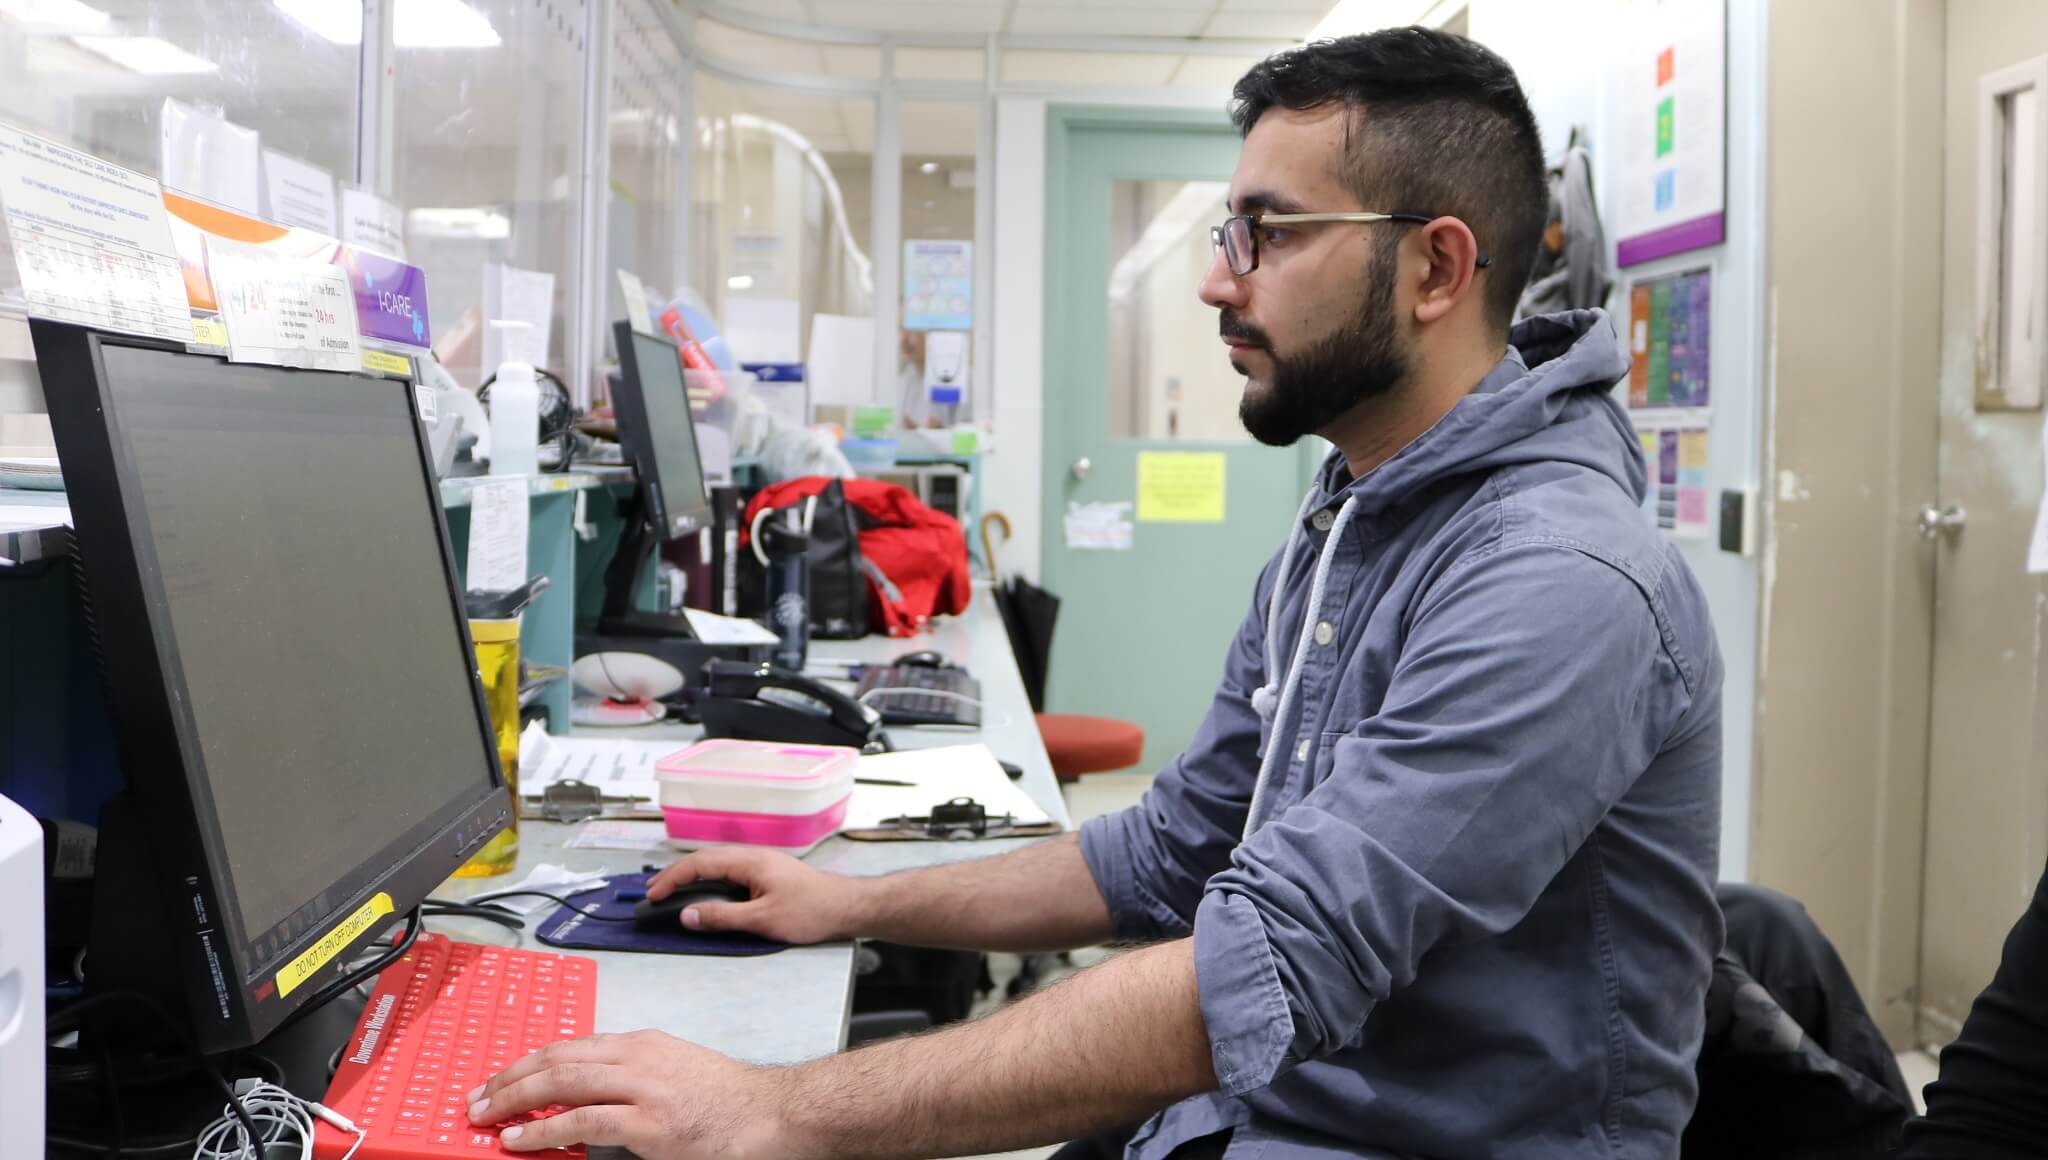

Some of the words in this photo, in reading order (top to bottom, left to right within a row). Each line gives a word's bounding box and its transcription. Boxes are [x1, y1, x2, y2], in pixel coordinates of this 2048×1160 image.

[324, 310, 337, 326] hrs
[378, 290, 413, 317] I-CARE
[295, 961, 307, 977] DO
[305, 950, 319, 970] NOT
[318, 938, 335, 959] TURN
[334, 928, 345, 946] OFF
[345, 906, 373, 936] COMPUTER
[364, 994, 395, 1030] Workstation
[349, 1030, 380, 1065] Downtime
